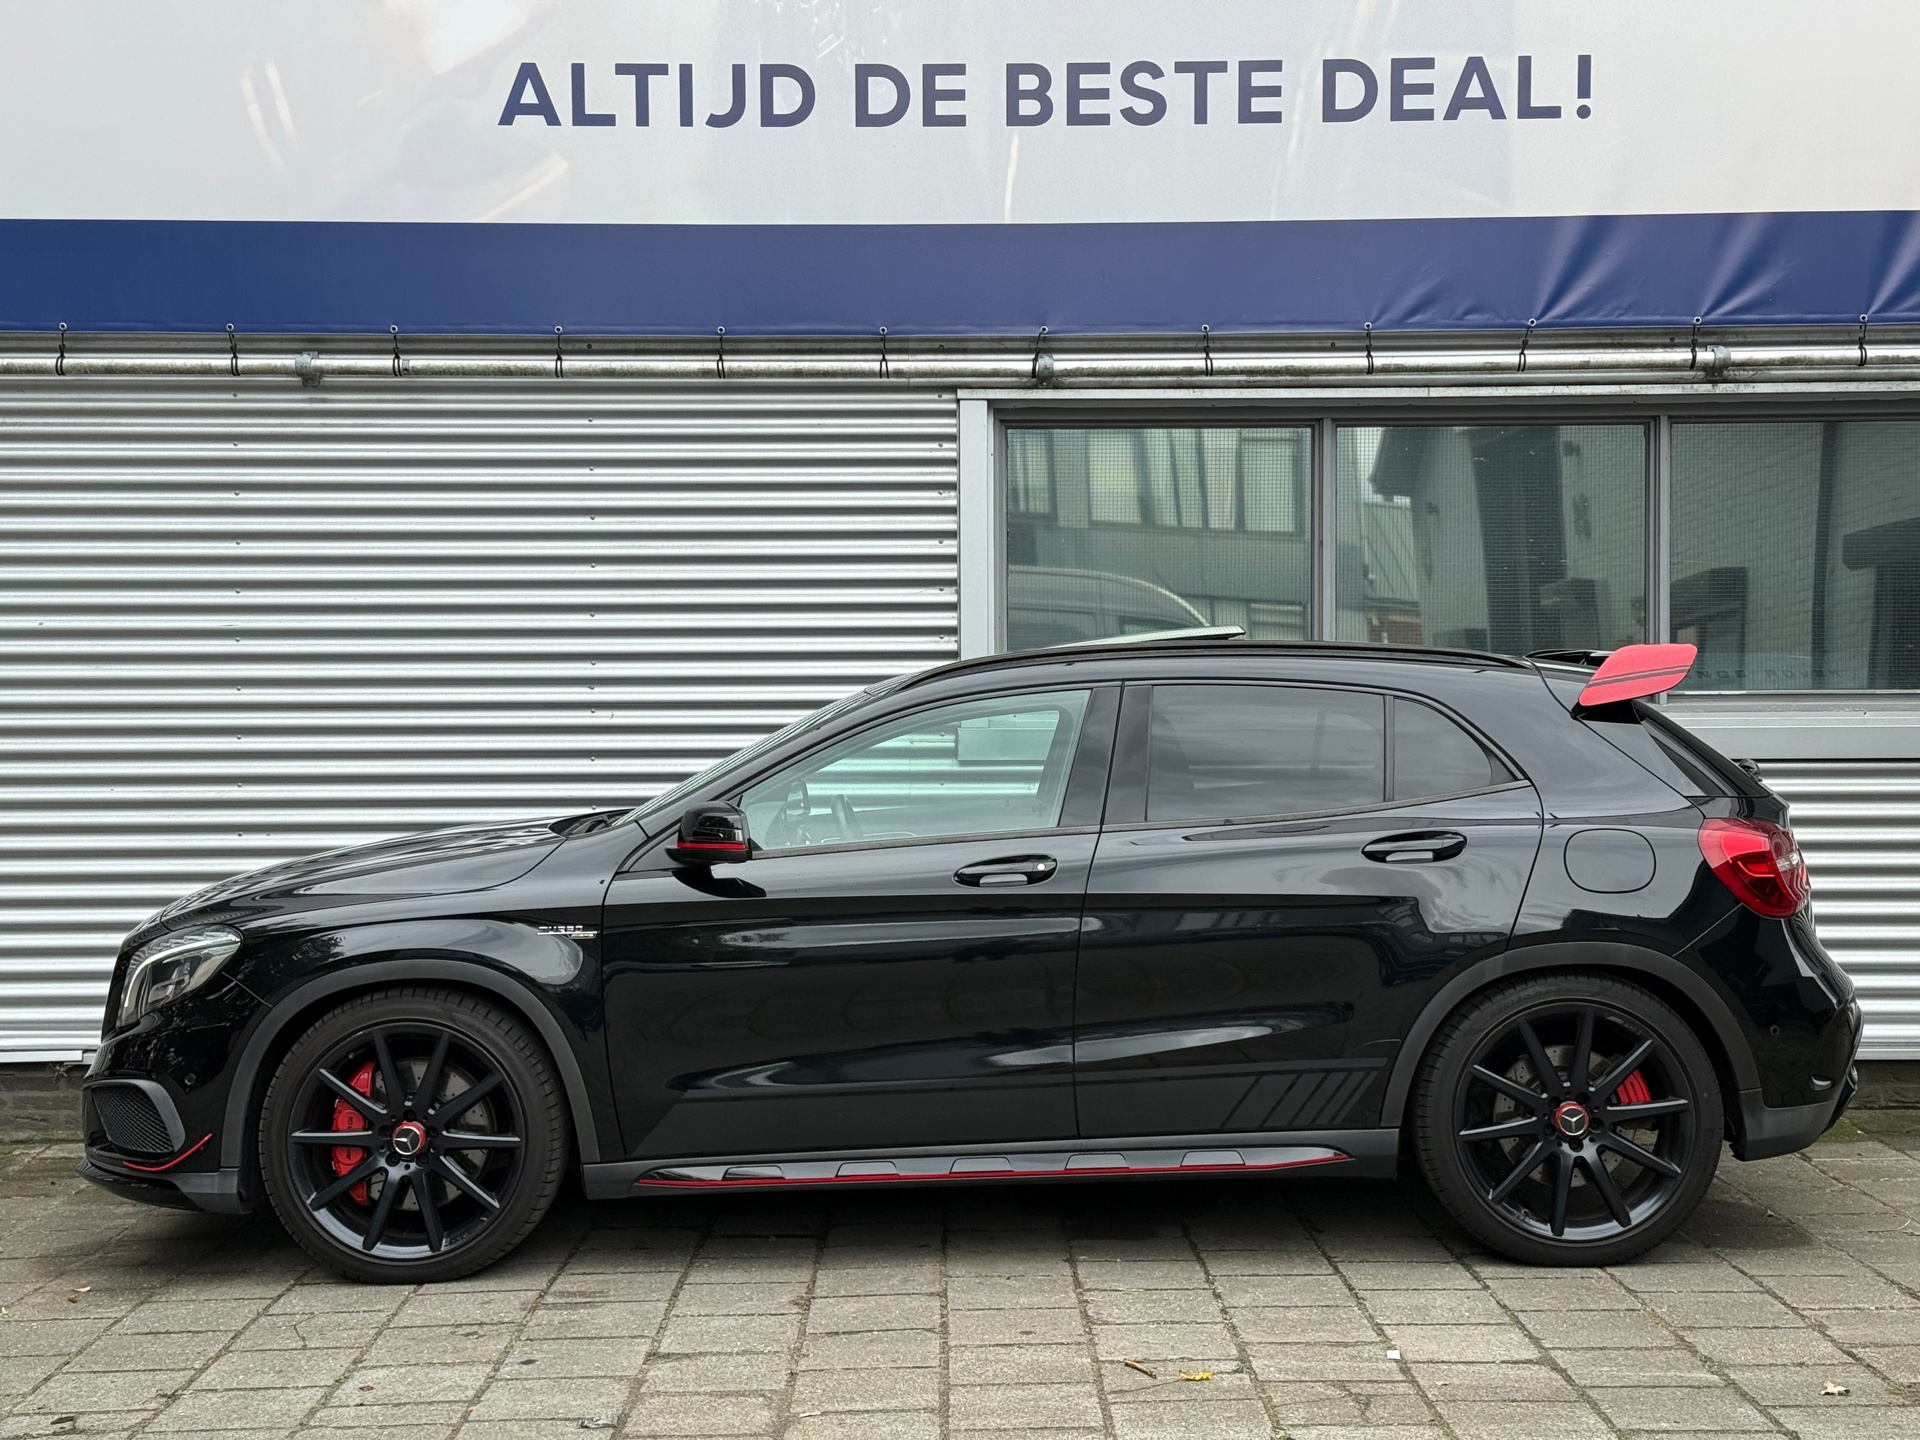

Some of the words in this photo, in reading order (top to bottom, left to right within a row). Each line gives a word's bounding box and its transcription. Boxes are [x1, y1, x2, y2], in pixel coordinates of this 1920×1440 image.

[497, 62, 816, 128] ALTIJD
[854, 62, 967, 128] DE
[1005, 59, 1283, 127] BESTE
[1322, 54, 1592, 123] DEAL!
